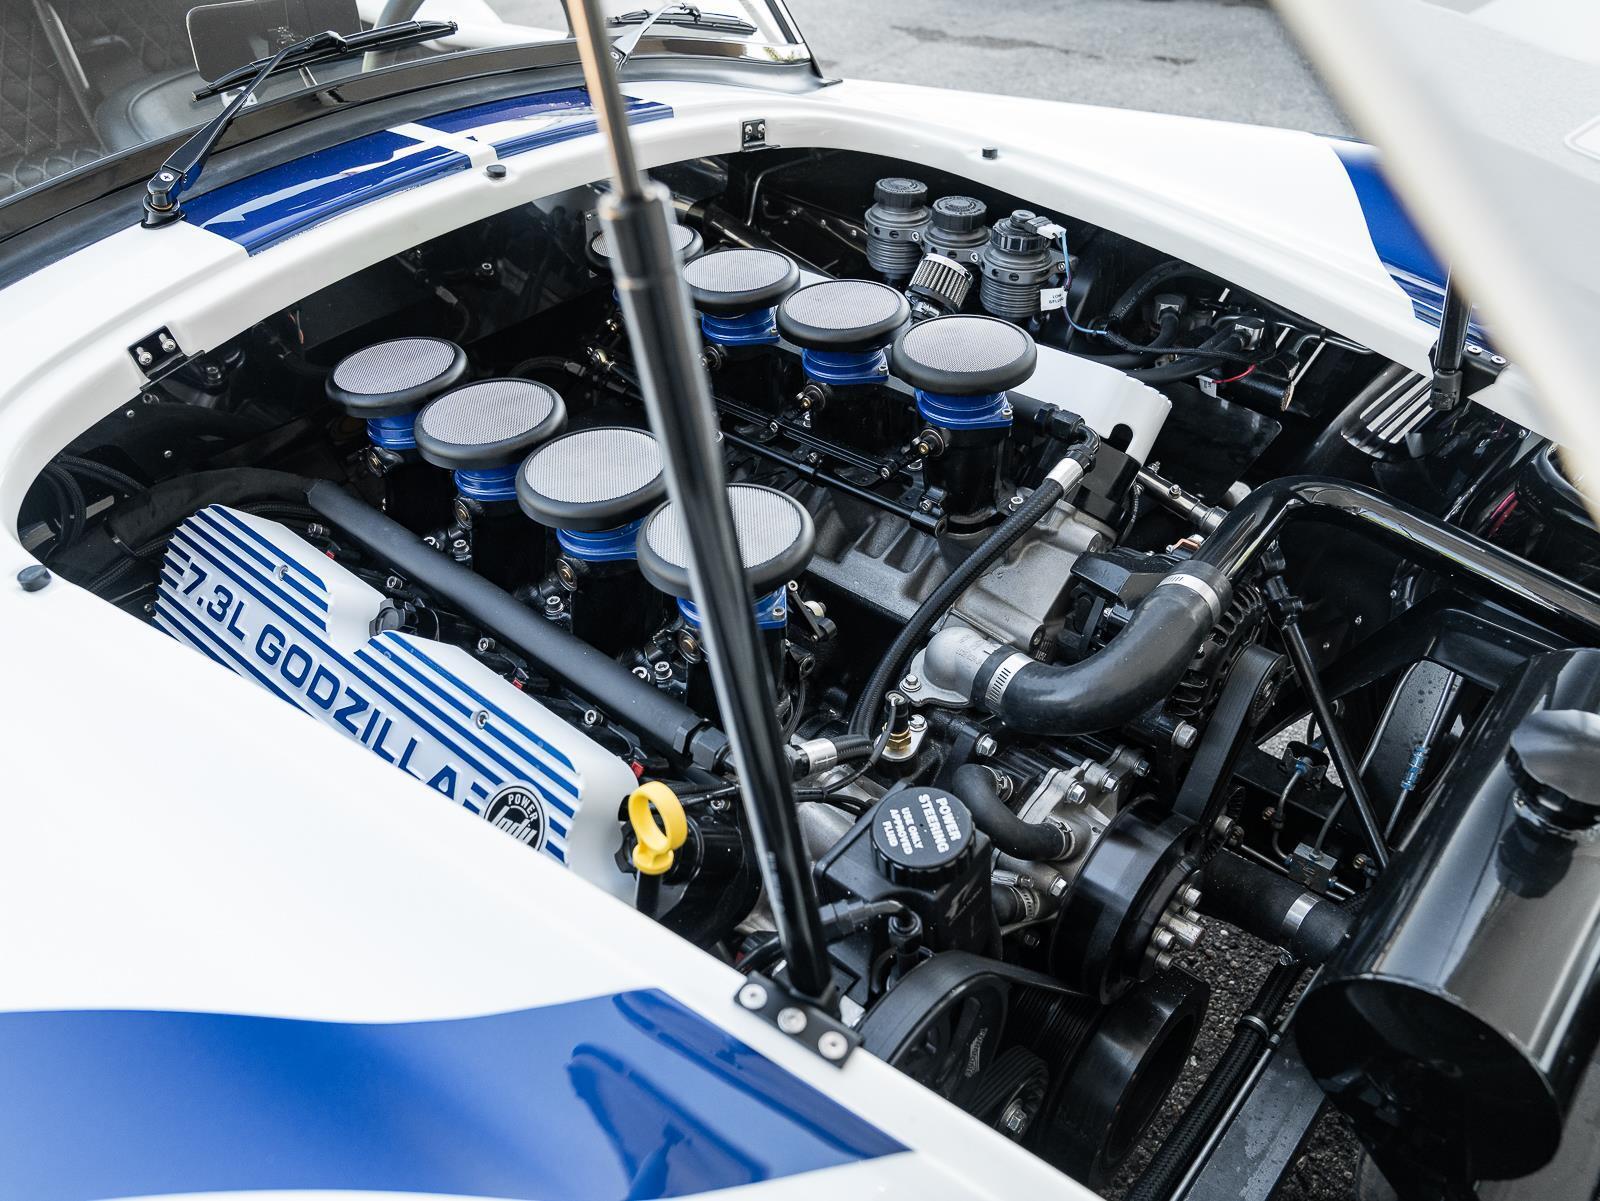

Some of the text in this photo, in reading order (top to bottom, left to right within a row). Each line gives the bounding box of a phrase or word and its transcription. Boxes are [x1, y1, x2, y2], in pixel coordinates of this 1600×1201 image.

[182, 562, 456, 802] 7.3L GODZILLA
[508, 794, 538, 822] POWER
[901, 807, 924, 849] USE ONLY
[918, 794, 950, 853] STEERING
[936, 797, 961, 841] POWER
[882, 820, 899, 847] FLUID
[889, 809, 913, 855] APPROVED
